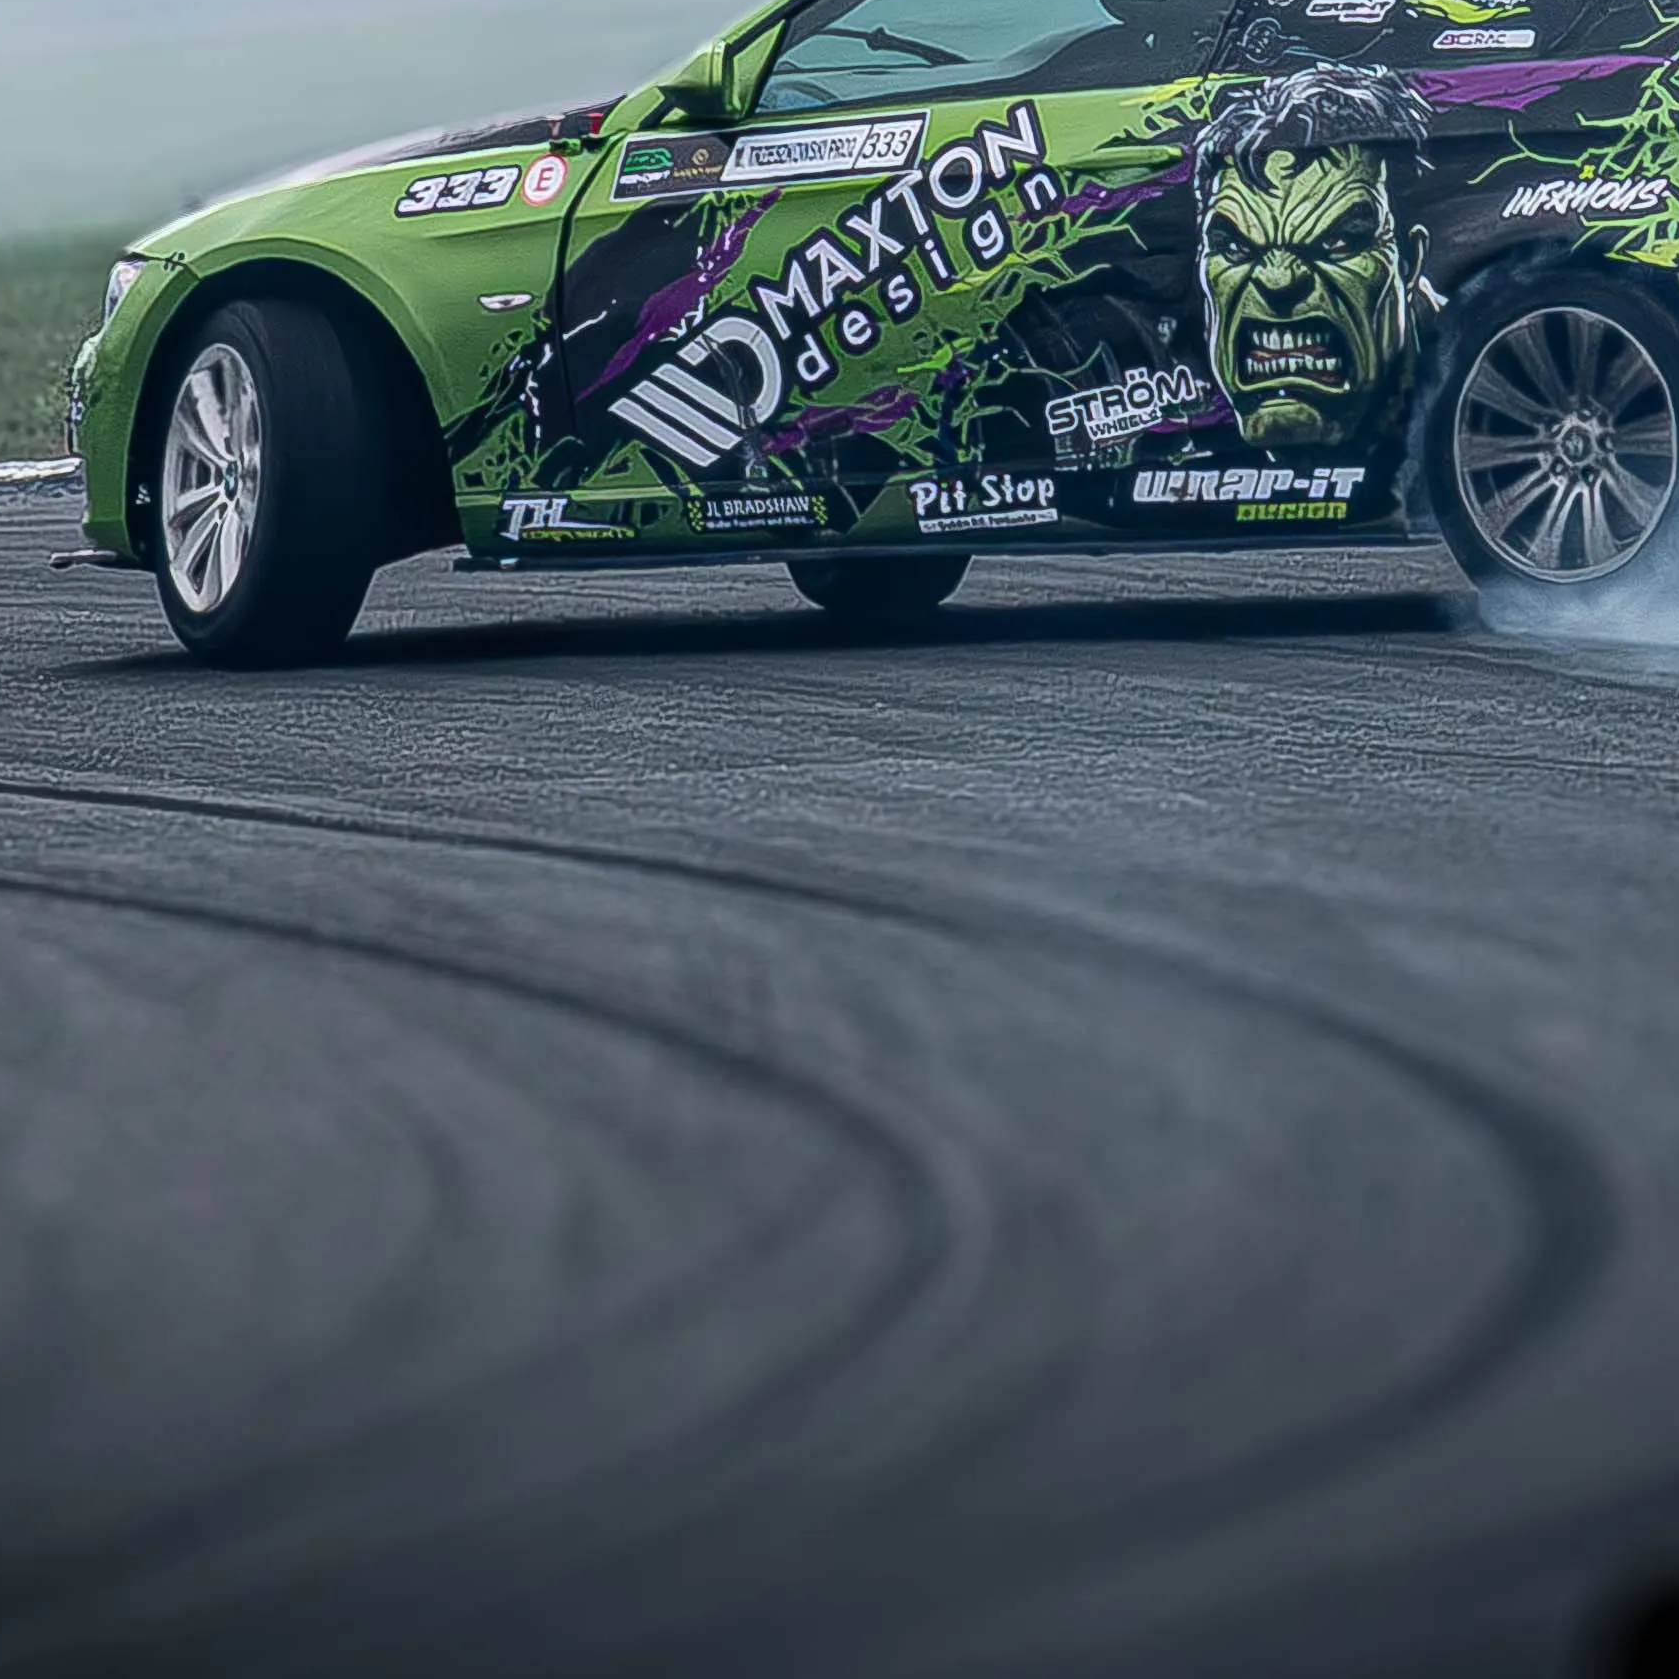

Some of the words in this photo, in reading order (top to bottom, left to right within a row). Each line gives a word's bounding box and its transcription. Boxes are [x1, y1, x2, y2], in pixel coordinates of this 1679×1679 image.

[863, 128, 911, 160] 333
[398, 168, 519, 212] 333
[533, 167, 554, 192] E
[757, 107, 1040, 340] MAXTON
[795, 172, 1058, 382] design
[723, 496, 810, 516] BRADSHAW
[909, 480, 967, 516] Pit
[981, 474, 1055, 507] Stop
